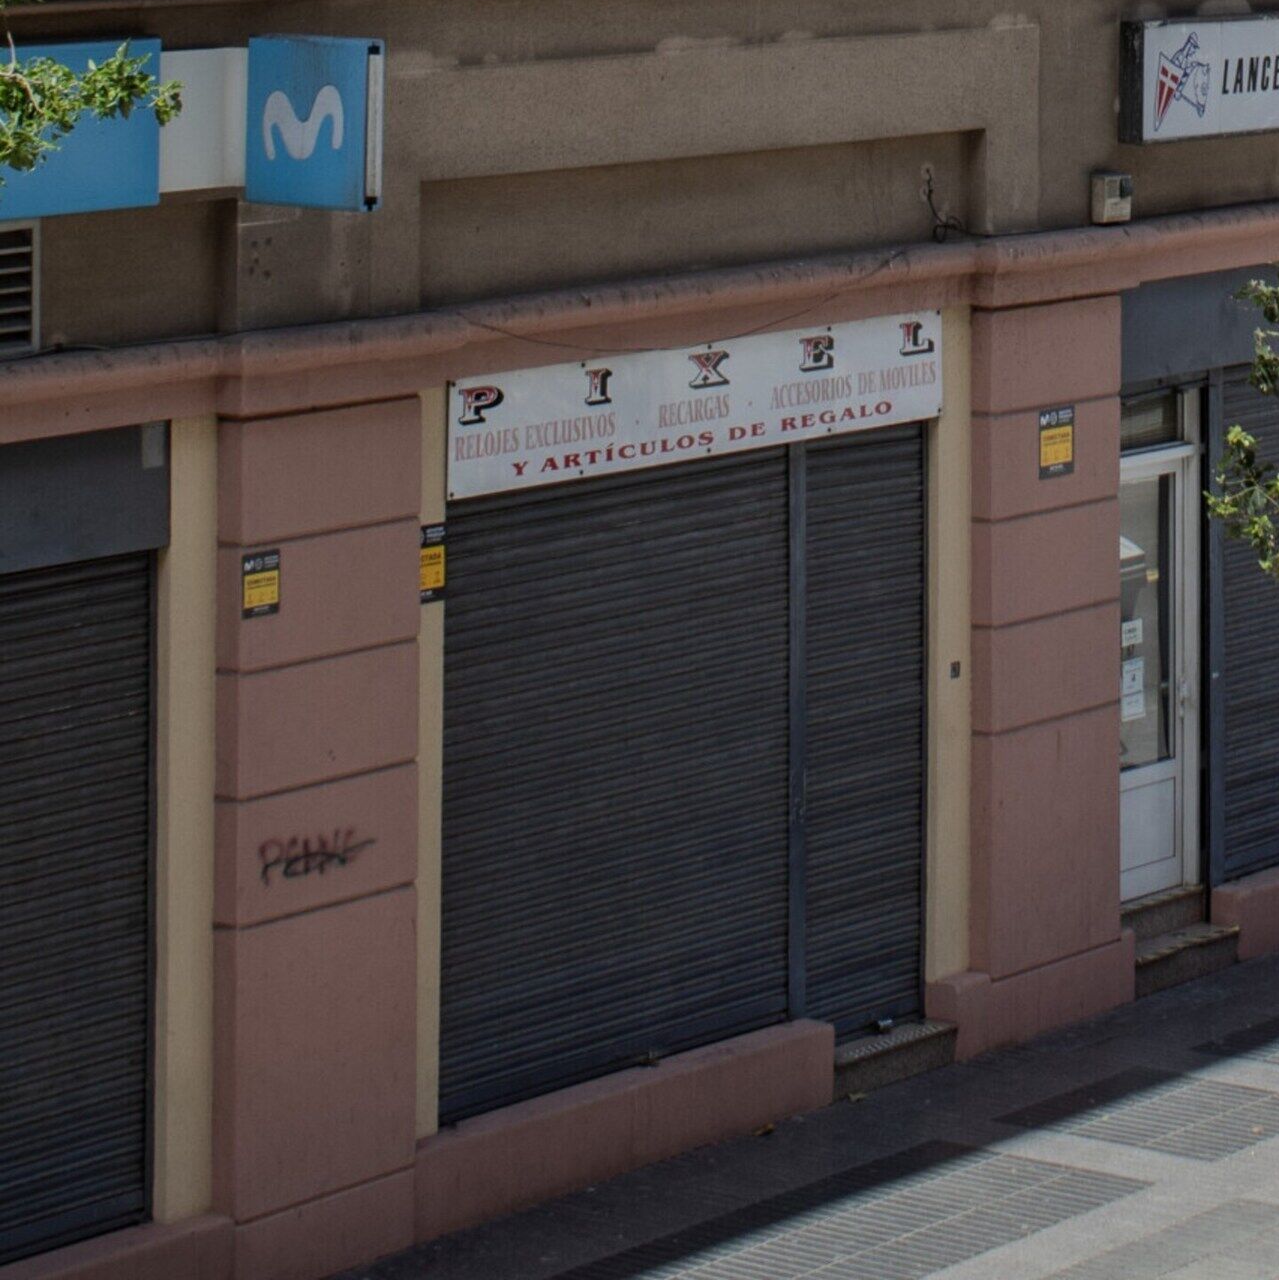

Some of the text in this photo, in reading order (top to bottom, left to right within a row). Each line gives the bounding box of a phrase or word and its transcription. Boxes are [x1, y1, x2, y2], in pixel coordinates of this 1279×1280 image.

[455, 360, 936, 462] RELOJES EXCLUSIVOS RECARGAS ACCESORIOS DE MOVILES
[458, 320, 935, 426] PIXEL
[512, 401, 892, 476] Y ARTÍCULOS DE REGALO
